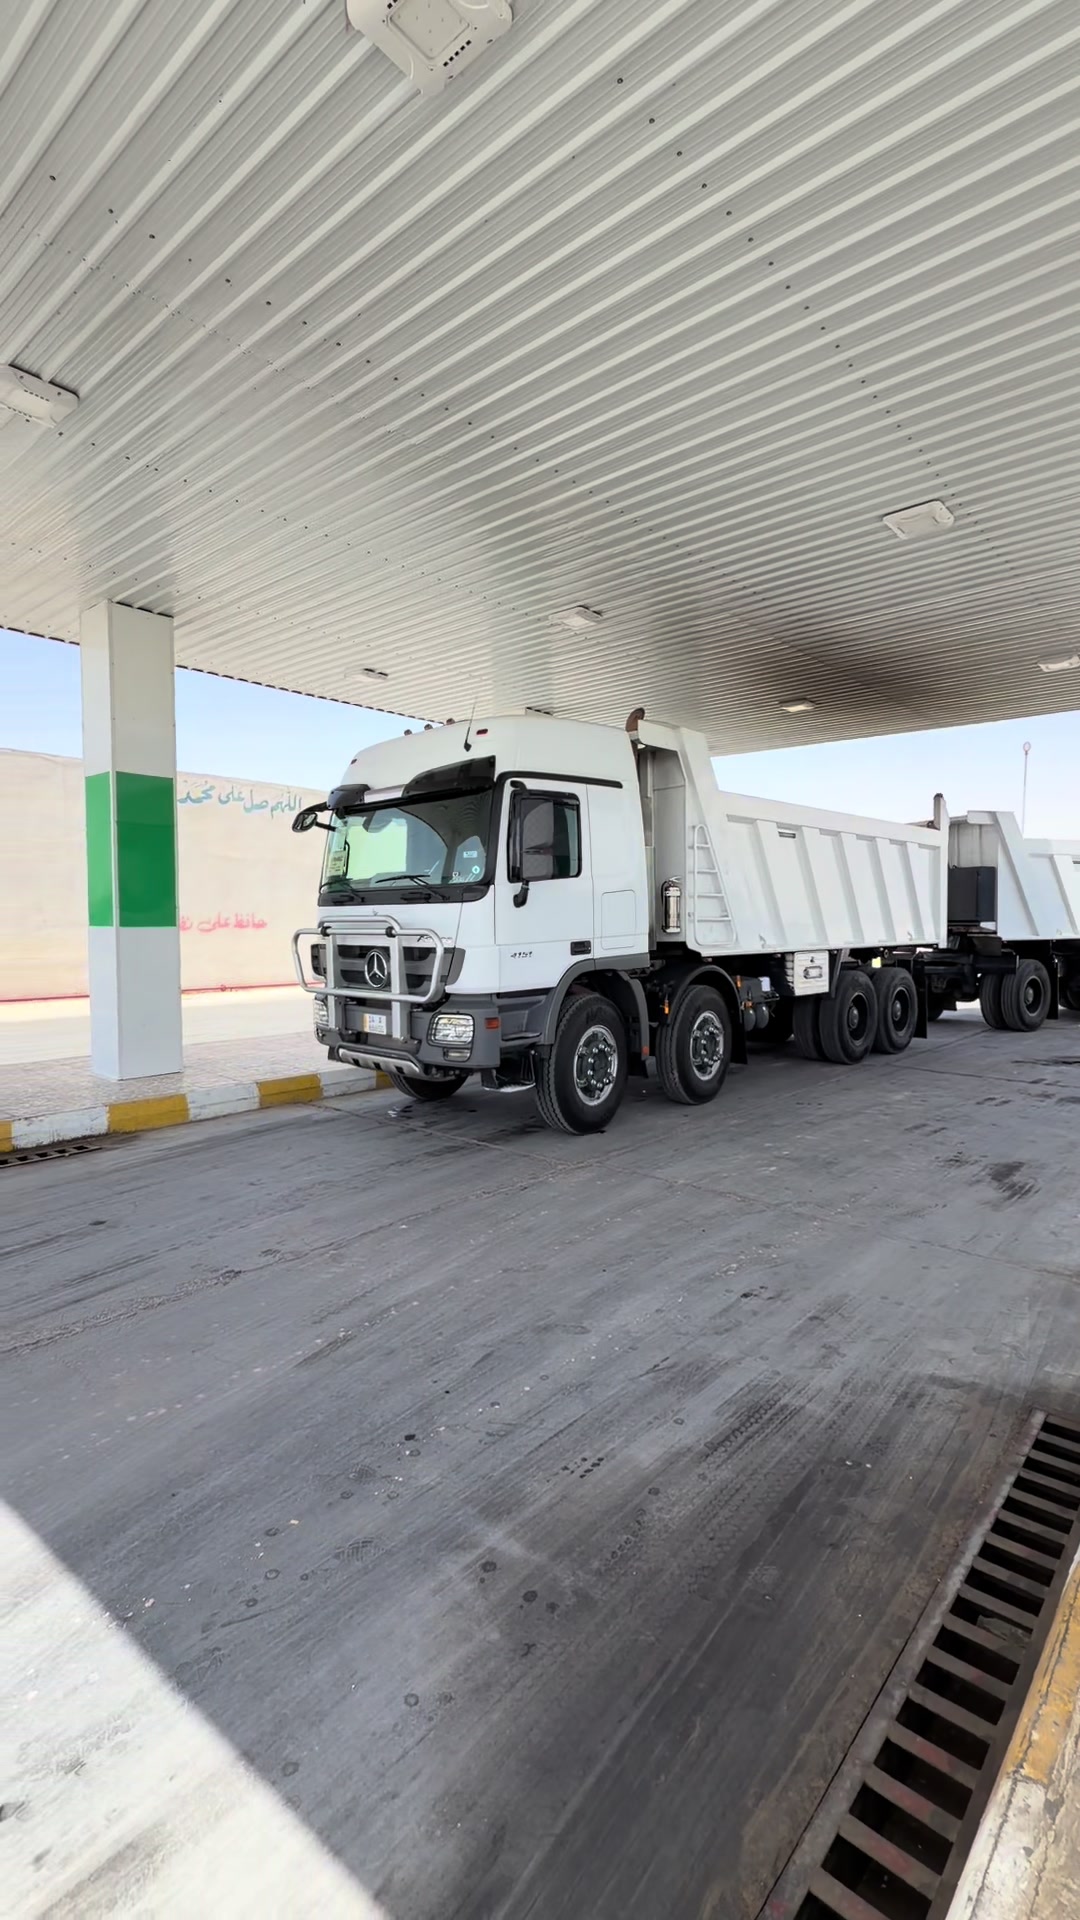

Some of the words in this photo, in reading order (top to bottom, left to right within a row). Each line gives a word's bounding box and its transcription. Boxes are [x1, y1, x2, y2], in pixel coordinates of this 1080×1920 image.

[218, 785, 245, 805] على
[243, 789, 269, 813] صل
[197, 911, 231, 932] على
[233, 912, 267, 929] حافظ
